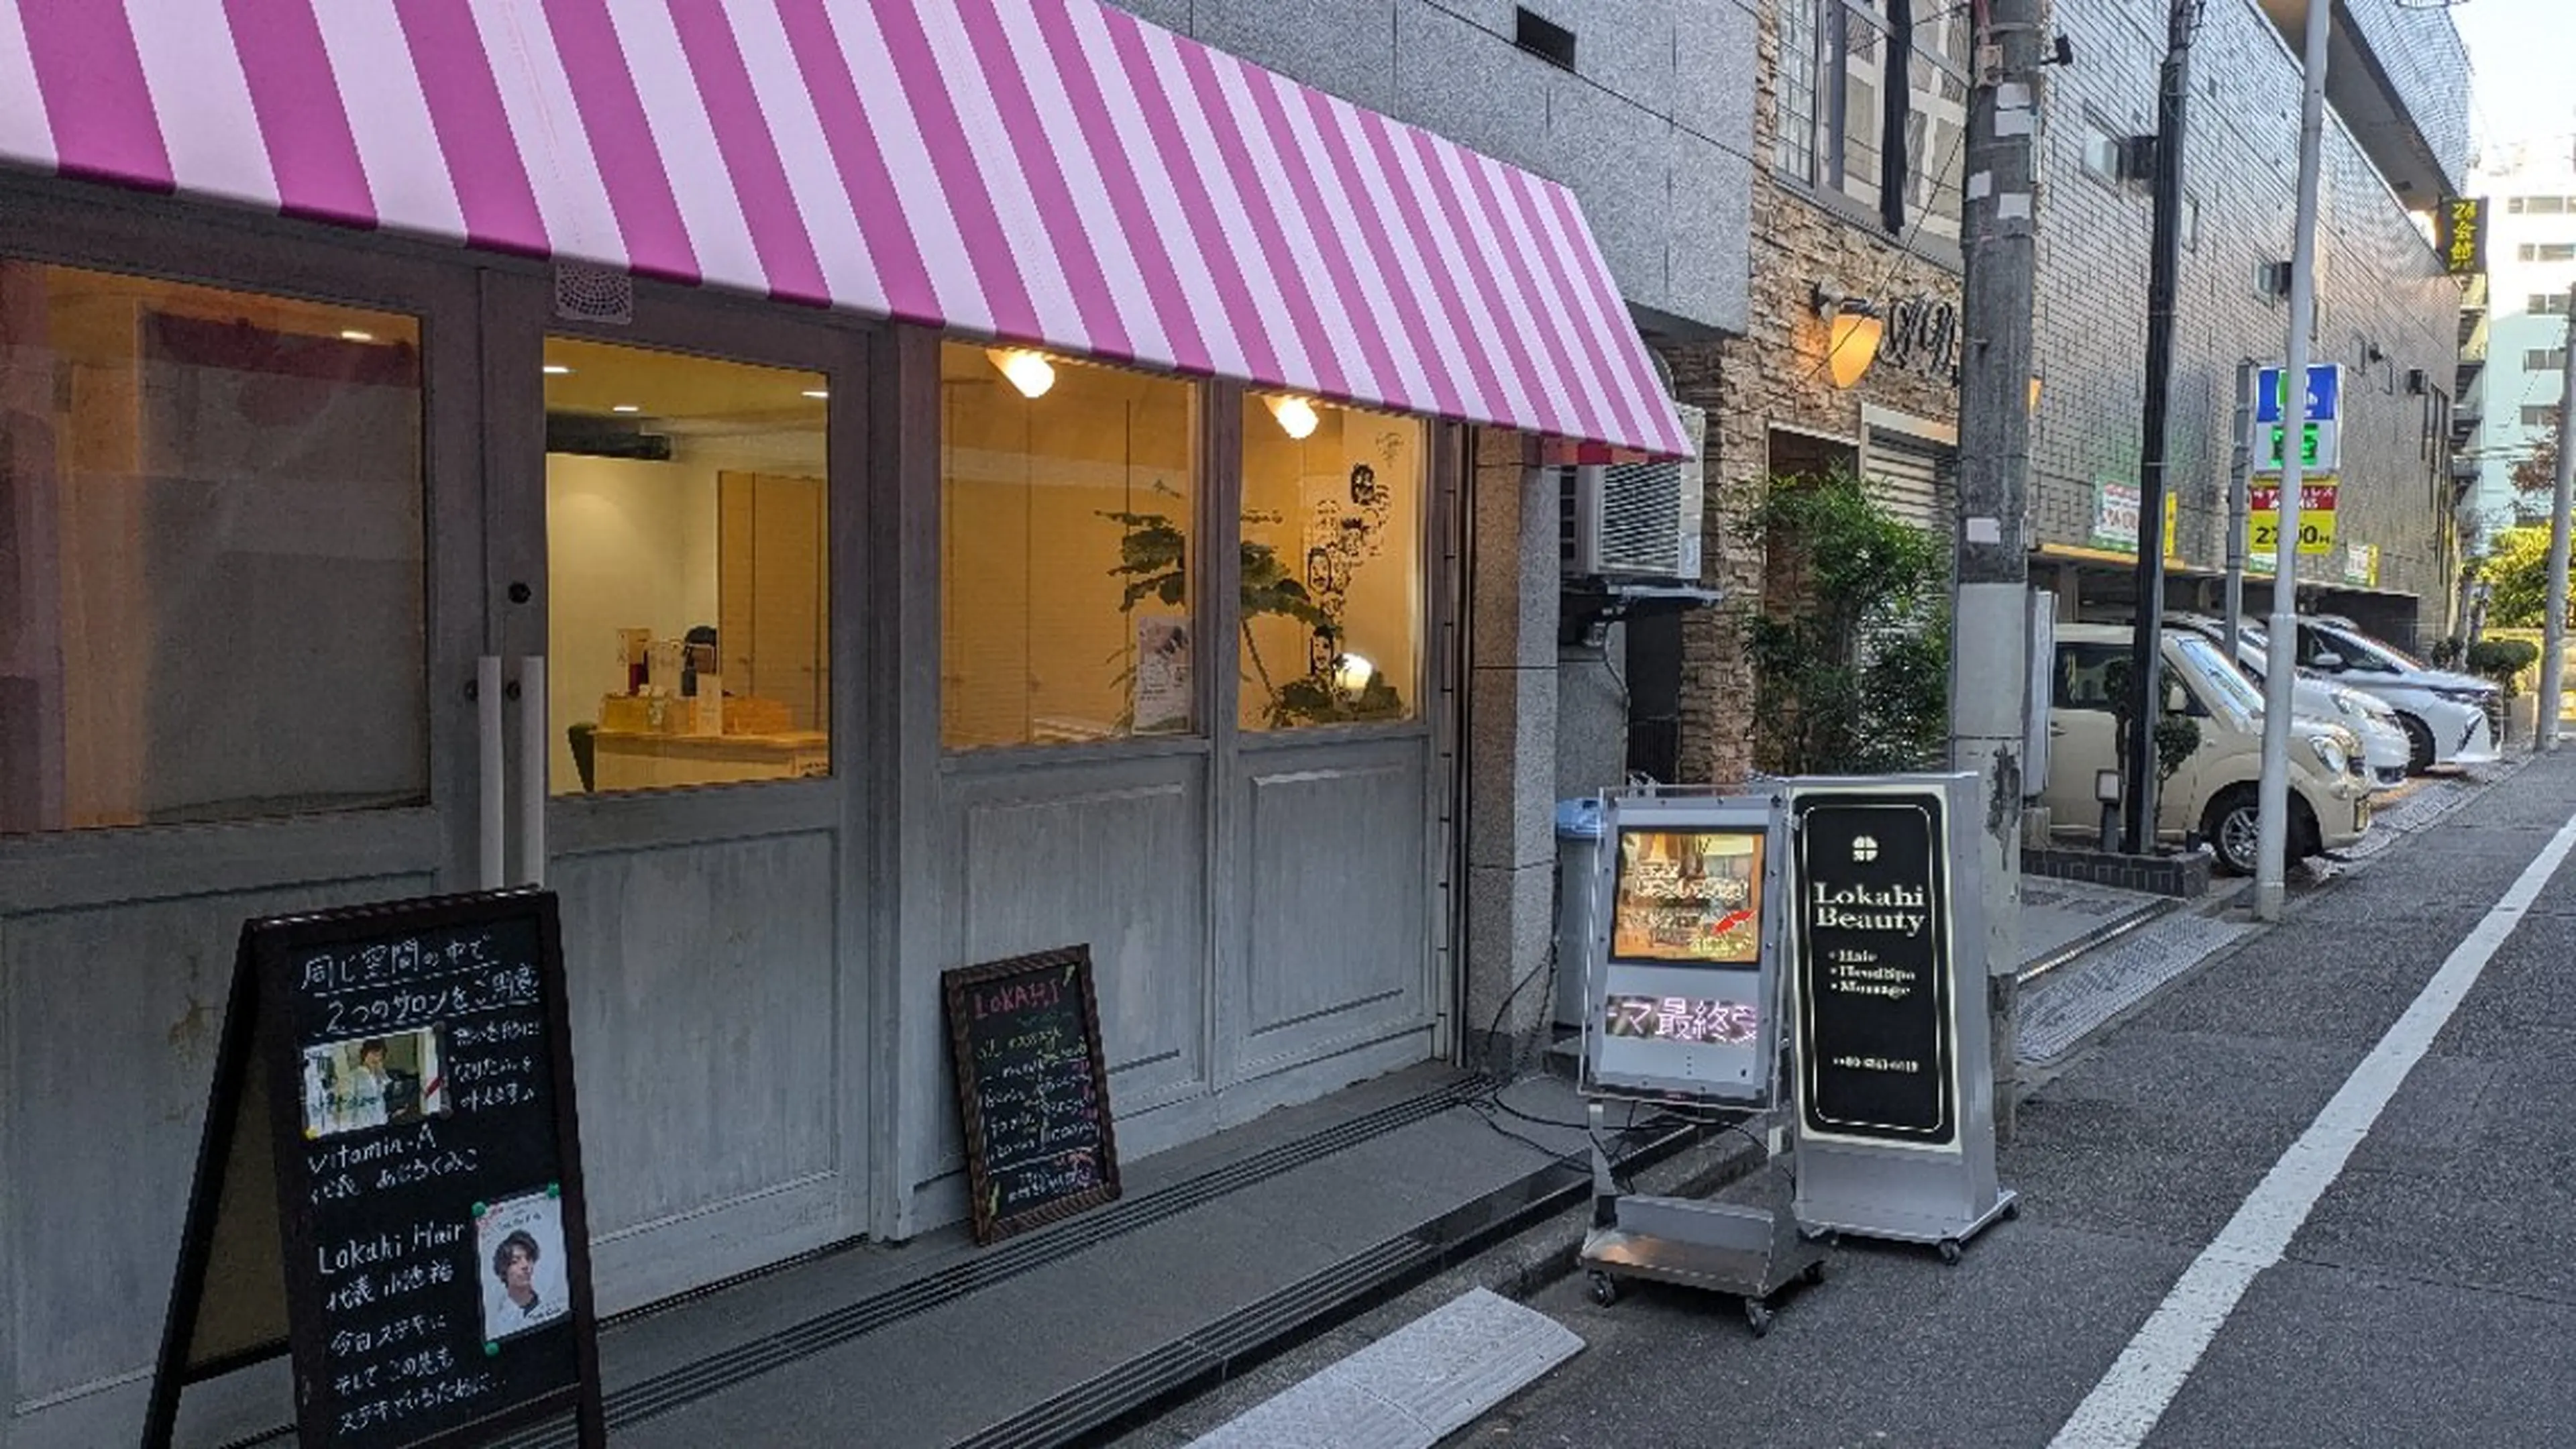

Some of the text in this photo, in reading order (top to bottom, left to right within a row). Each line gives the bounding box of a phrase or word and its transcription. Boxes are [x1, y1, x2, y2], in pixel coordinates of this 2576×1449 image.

[1813, 881, 1925, 907] Lokahi
[1816, 906, 1927, 938] Beauty
[319, 1233, 402, 1274] Lokahi
[412, 1220, 466, 1252] Hair
